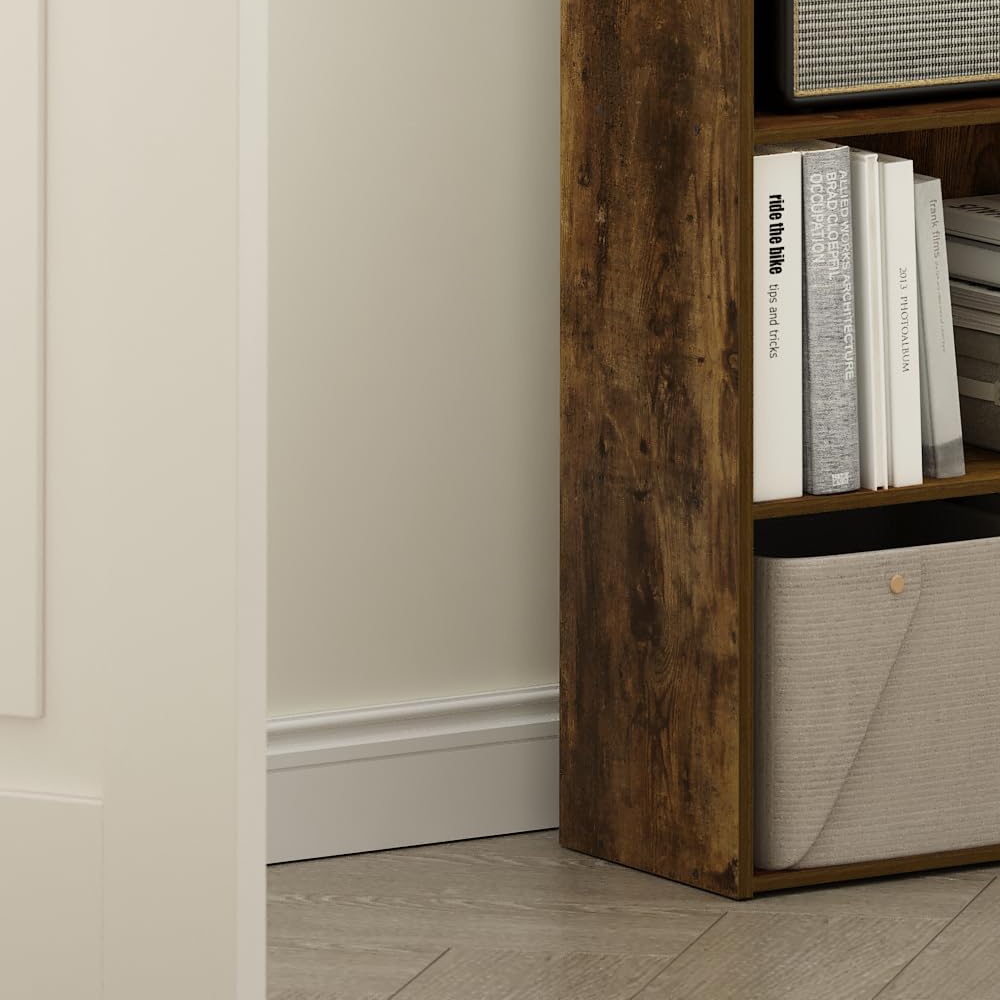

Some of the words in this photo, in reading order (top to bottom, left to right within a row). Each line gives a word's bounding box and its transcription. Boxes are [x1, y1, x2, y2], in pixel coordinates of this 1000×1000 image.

[826, 172, 838, 211] BRAD
[838, 170, 849, 218] ALLIED
[768, 194, 784, 221] ride
[810, 173, 825, 264] OCCUPATION
[929, 199, 940, 228] frank
[768, 222, 784, 244] the
[840, 220, 851, 270] WORKS
[932, 230, 941, 258] films
[768, 246, 784, 275] bike
[768, 283, 778, 304] tips
[898, 268, 908, 290] 2013
[769, 306, 778, 326] and
[842, 273, 854, 381] ARCHITECTURE
[769, 328, 778, 359] tricks
[899, 296, 910, 373] PHOTOALBUM
